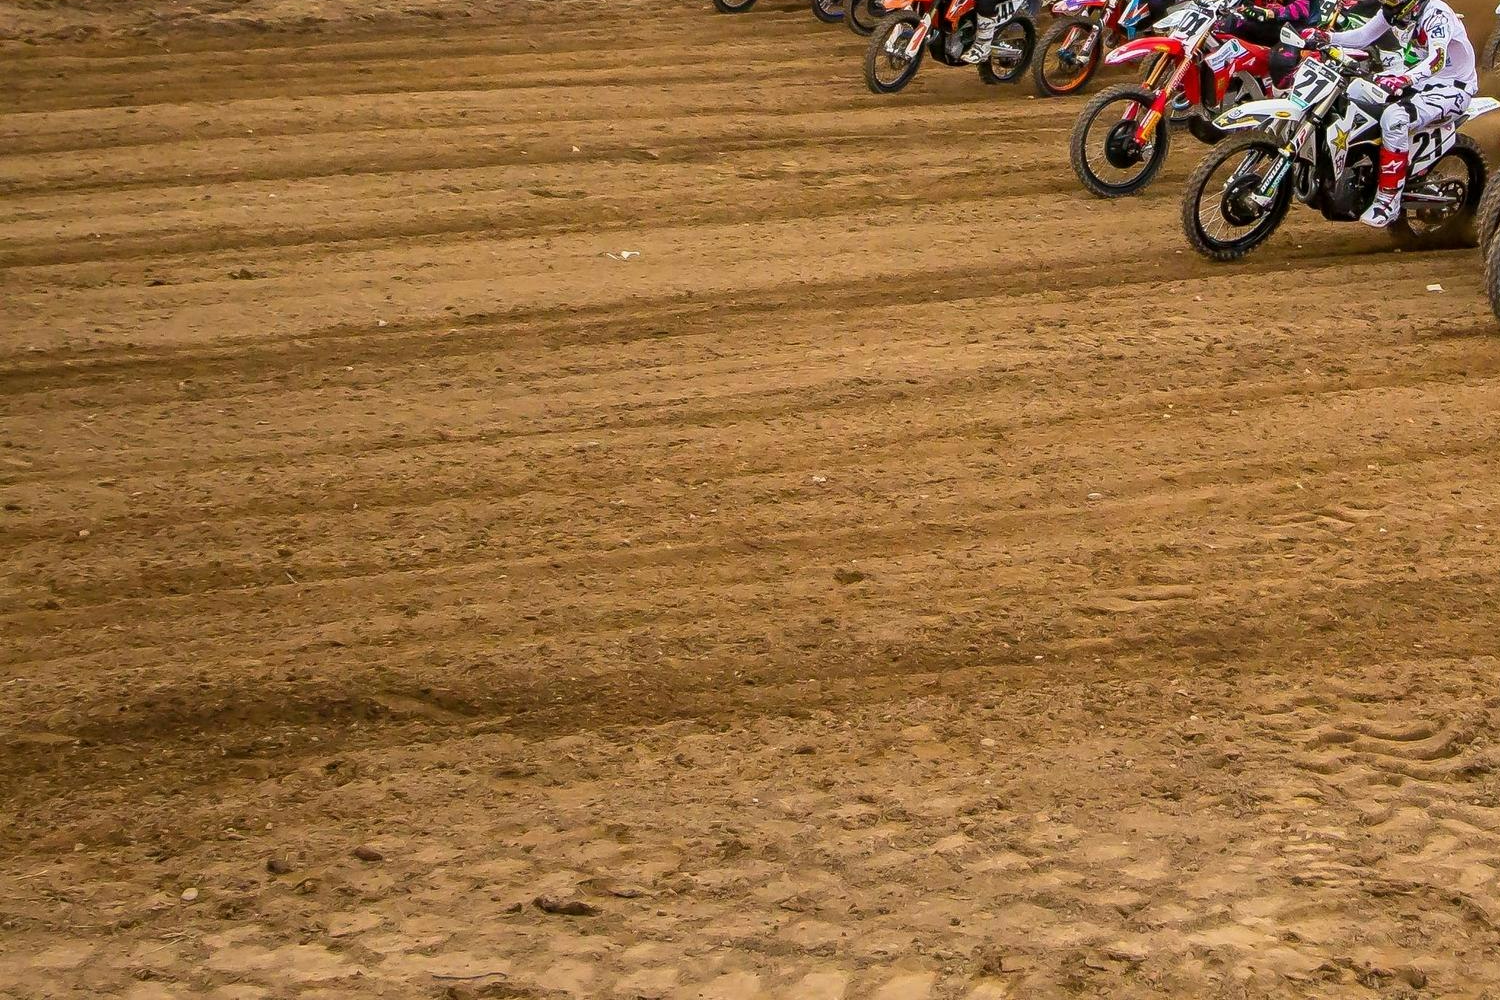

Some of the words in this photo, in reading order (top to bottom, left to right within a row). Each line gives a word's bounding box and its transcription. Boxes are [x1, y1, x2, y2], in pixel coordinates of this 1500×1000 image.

[1293, 69, 1331, 103] 21
[1411, 127, 1443, 160] 21
[1260, 157, 1284, 194] DUNLOP
